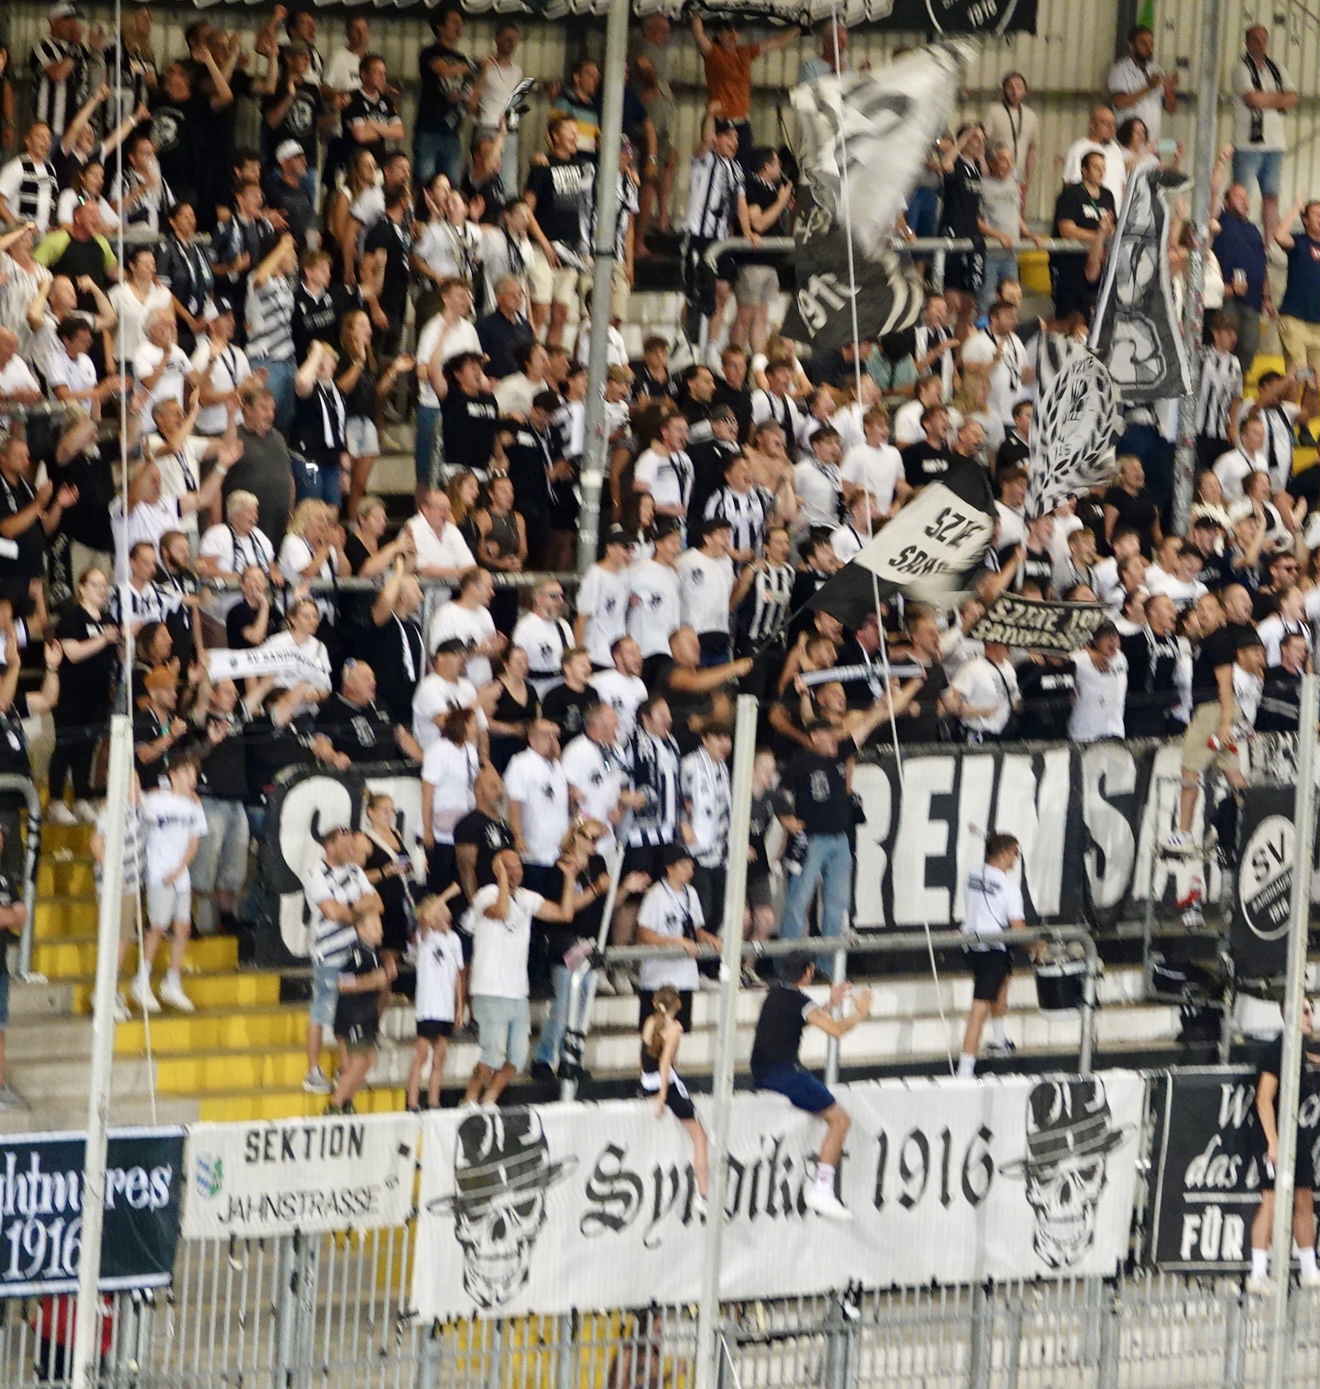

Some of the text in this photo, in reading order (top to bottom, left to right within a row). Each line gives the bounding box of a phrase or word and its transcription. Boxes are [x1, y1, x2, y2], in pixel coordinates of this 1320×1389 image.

[1252, 830, 1285, 881] SV
[244, 1124, 365, 1163] SEKTION
[873, 1124, 994, 1214] 1916
[217, 1185, 381, 1223] JAHNSTRASSE
[2, 1217, 82, 1282] 1916
[1179, 1203, 1245, 1261] FÜR
